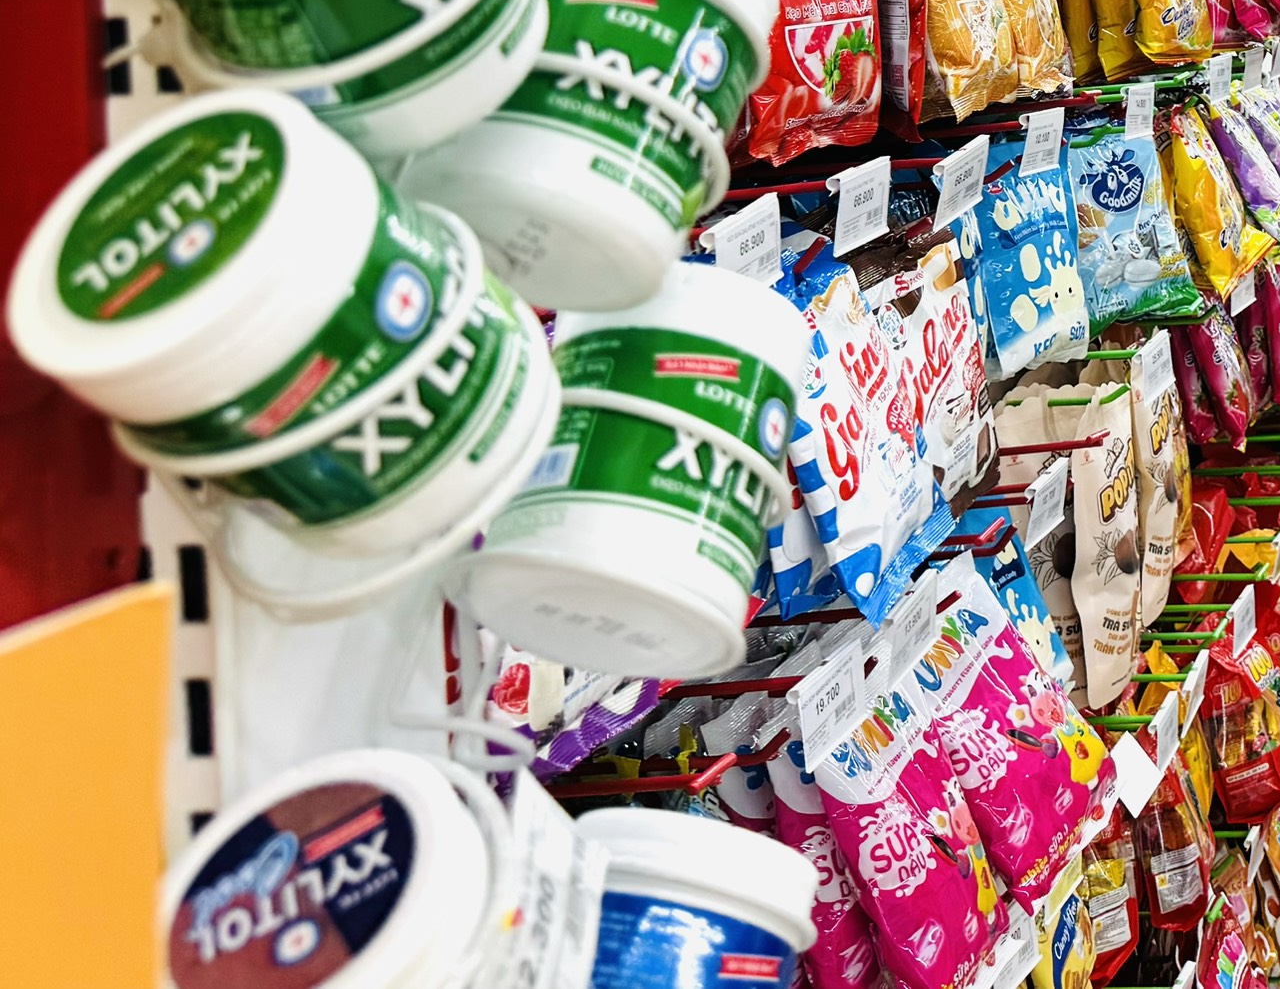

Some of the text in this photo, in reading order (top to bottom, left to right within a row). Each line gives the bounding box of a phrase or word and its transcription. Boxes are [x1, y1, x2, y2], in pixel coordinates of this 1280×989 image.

[604, 4, 680, 46] LOTTE
[853, 187, 875, 209] 66.900
[1098, 176, 1143, 209] Goodmilk
[71, 130, 264, 293] XYLITOL
[739, 229, 766, 257] 66.900
[695, 380, 757, 416] LOTTE
[815, 681, 841, 716] 19.700
[979, 747, 1008, 779] DÂU
[869, 819, 922, 875] SỮA
[899, 850, 928, 884] DÂU
[184, 829, 392, 963] XYLITOL
